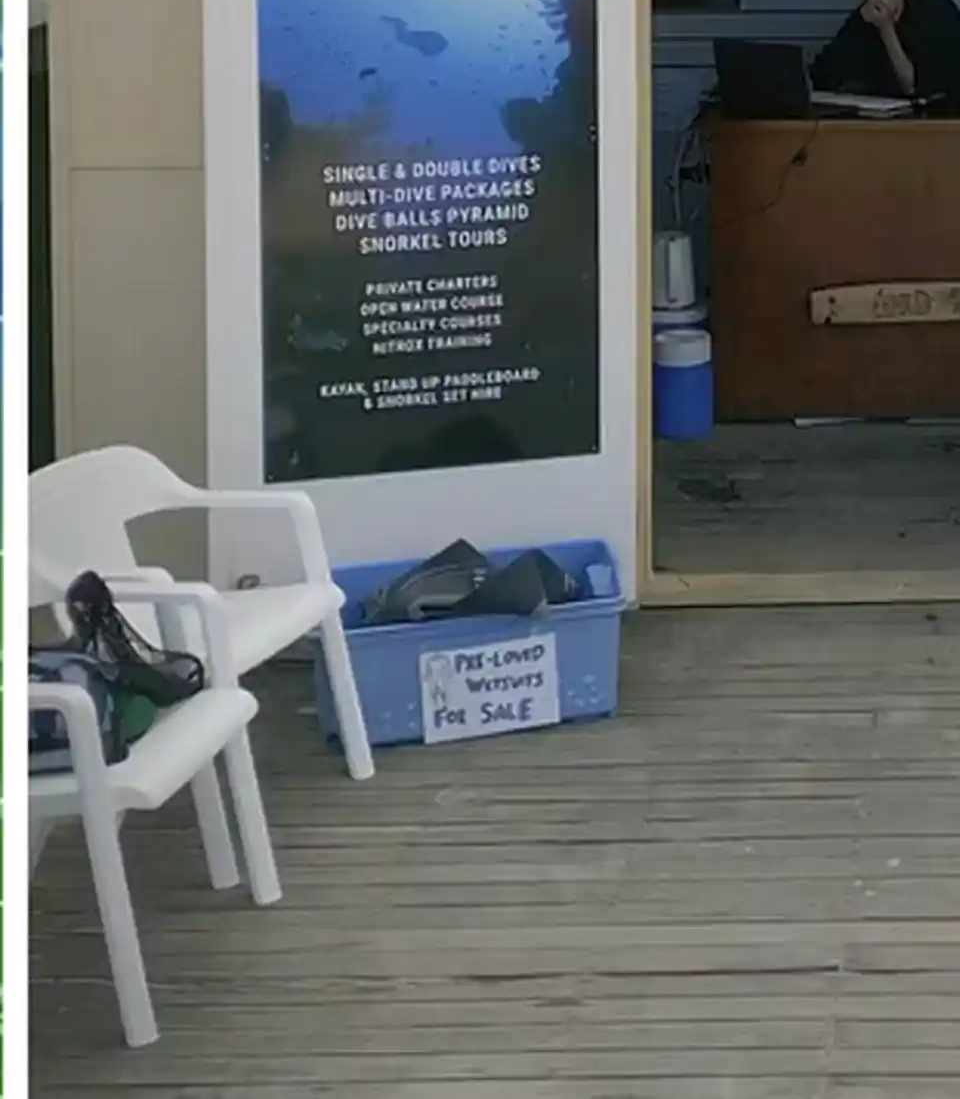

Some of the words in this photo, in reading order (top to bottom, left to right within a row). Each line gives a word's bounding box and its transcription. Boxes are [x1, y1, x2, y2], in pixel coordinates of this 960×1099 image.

[322, 162, 390, 184] SINGLE
[393, 162, 406, 180] &
[412, 158, 483, 178] DOUBLE
[486, 155, 542, 175] DIVES
[329, 185, 436, 208] MULTI-DIVE
[440, 179, 536, 201] PACKAGES
[335, 212, 378, 232] DIVE
[383, 208, 442, 229] BALLS
[446, 203, 530, 225] PYRAMID
[358, 233, 443, 255] SNORKEL
[448, 227, 508, 248] TOURS
[365, 280, 423, 296] PRIVATE
[426, 274, 498, 293] CHARTERS
[360, 301, 398, 317] OPEN
[401, 298, 447, 313] WATER
[450, 293, 504, 311] COURSE
[363, 318, 436, 337] SPECIALTY
[440, 313, 502, 331] COURSES
[443, 366, 542, 388] PADDLEBOARD
[454, 644, 546, 673] PRE-LOVED
[465, 671, 544, 693] WETSUITS
[433, 705, 467, 729] FOR
[480, 698, 533, 725] SALE
